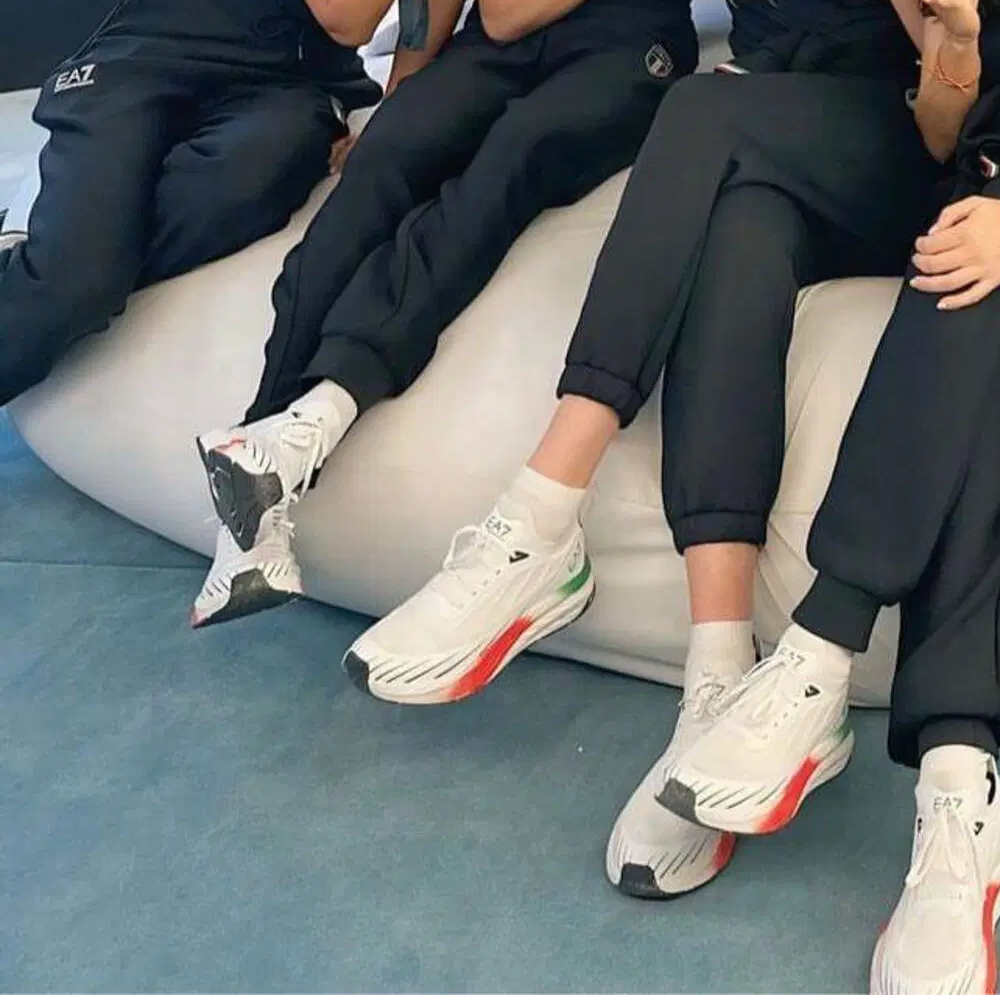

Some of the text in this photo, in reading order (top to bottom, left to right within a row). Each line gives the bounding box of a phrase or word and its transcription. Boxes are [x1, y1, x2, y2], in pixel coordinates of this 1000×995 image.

[55, 64, 96, 88] EA7
[485, 515, 512, 537] EA7
[933, 796, 963, 813] EA7
